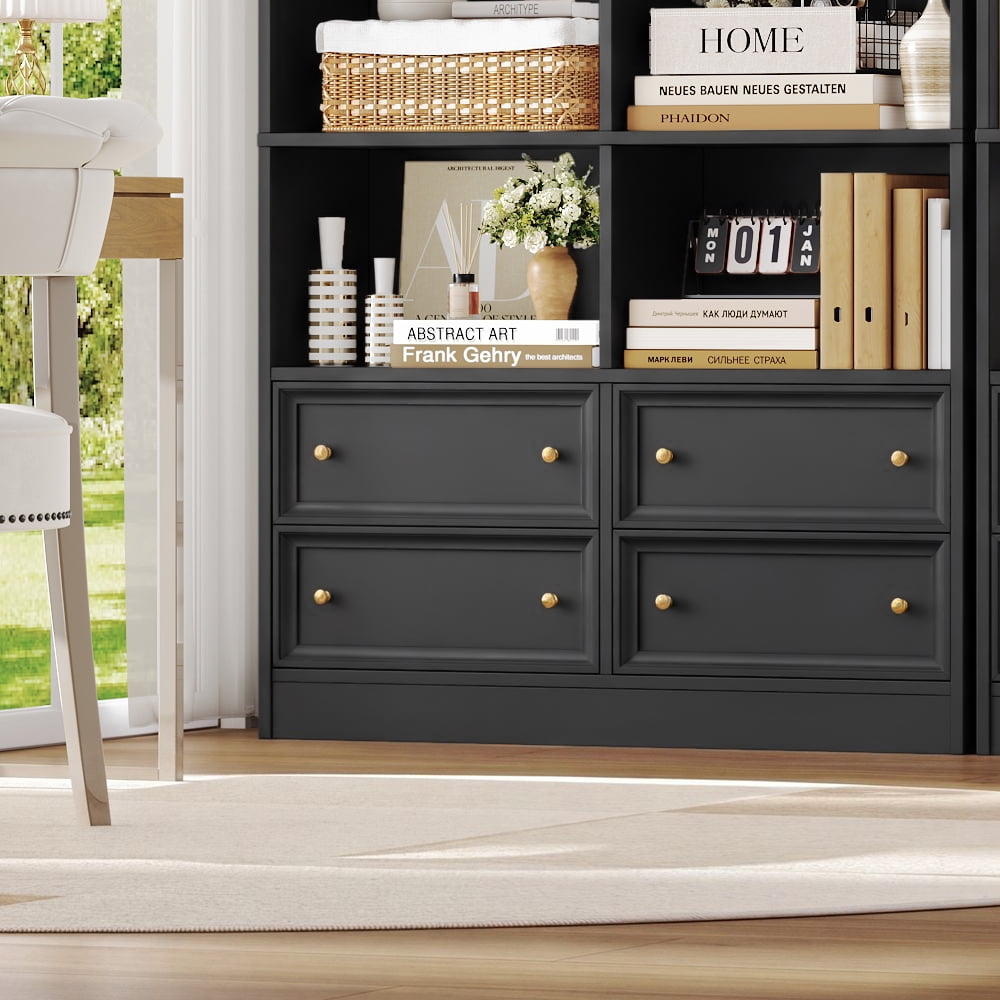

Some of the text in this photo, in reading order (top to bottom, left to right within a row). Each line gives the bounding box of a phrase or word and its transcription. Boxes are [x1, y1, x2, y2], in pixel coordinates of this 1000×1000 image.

[494, 3, 540, 15] ARCHITYPE
[700, 27, 804, 54] HOME
[659, 83, 846, 96] NEUES BAUEN NEUES GESTALTEN
[660, 113, 730, 124] PHAIDON
[705, 228, 719, 263] MON
[800, 225, 813, 266] JAN
[702, 310, 788, 319] КАК ЛЮДИ ДУМАЮТ
[408, 327, 517, 341] ABSTRACT ART
[402, 346, 457, 363] Frank
[463, 346, 522, 366] Gehry
[707, 356, 750, 364] СИЛЬНЕЕ
[754, 356, 786, 364] СТРАХА
